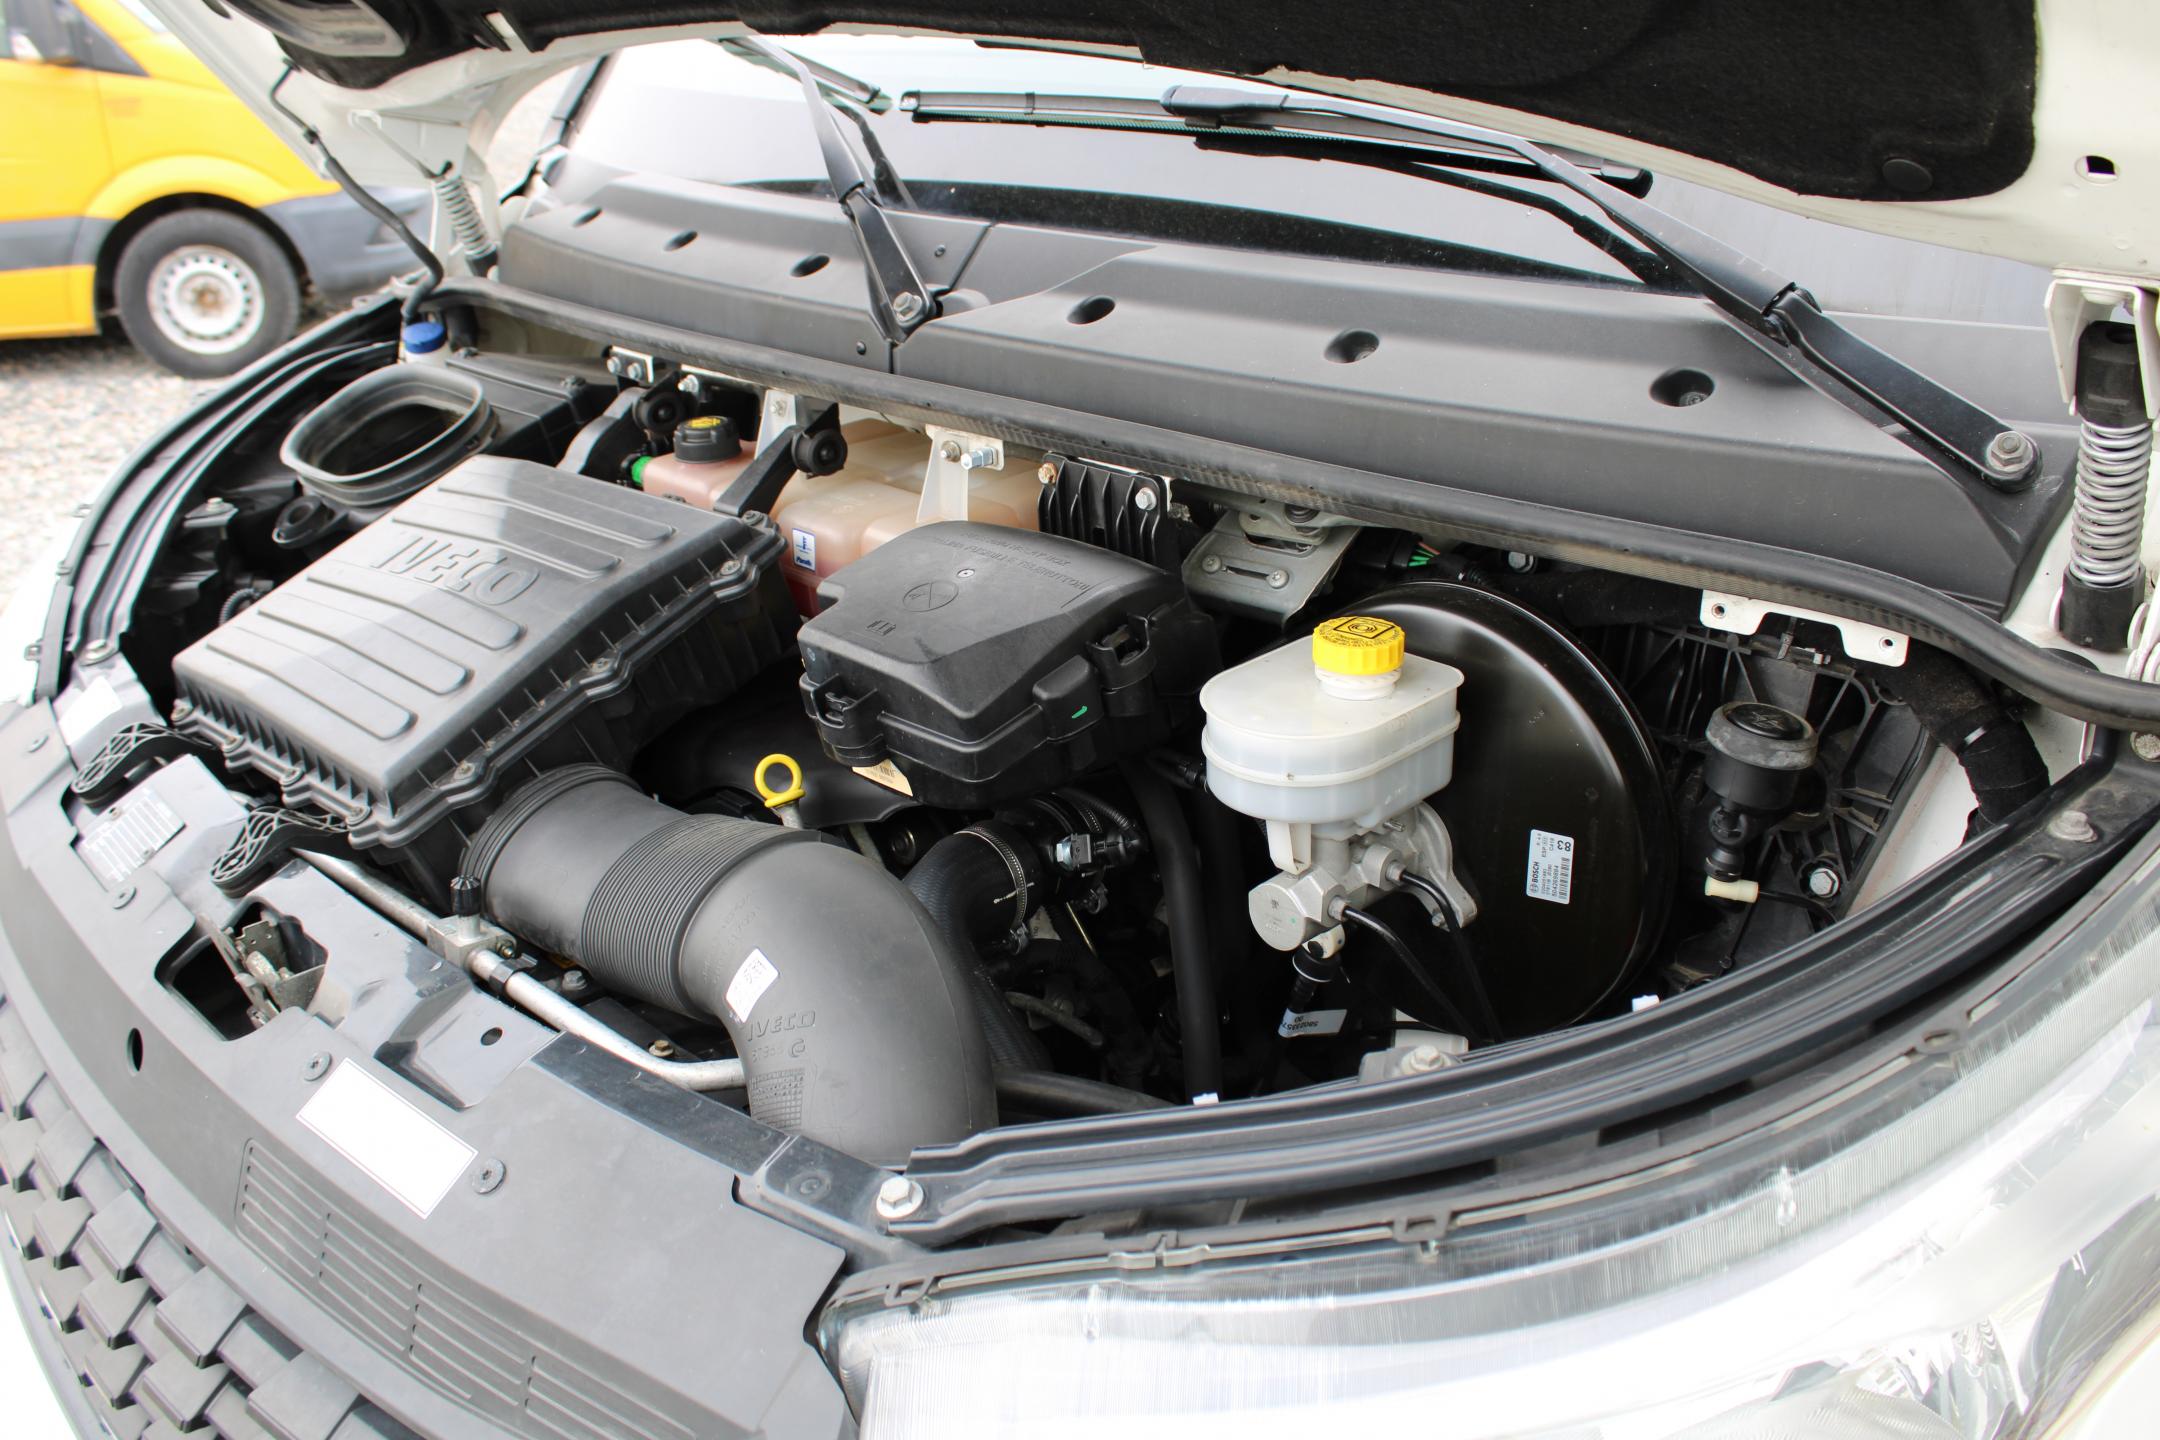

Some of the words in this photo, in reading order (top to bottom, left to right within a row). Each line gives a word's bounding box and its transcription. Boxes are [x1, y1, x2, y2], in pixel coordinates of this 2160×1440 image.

[370, 532, 541, 606] IVECO
[1531, 861, 1540, 884] BOSCH
[748, 1009, 816, 1042] IVECO
